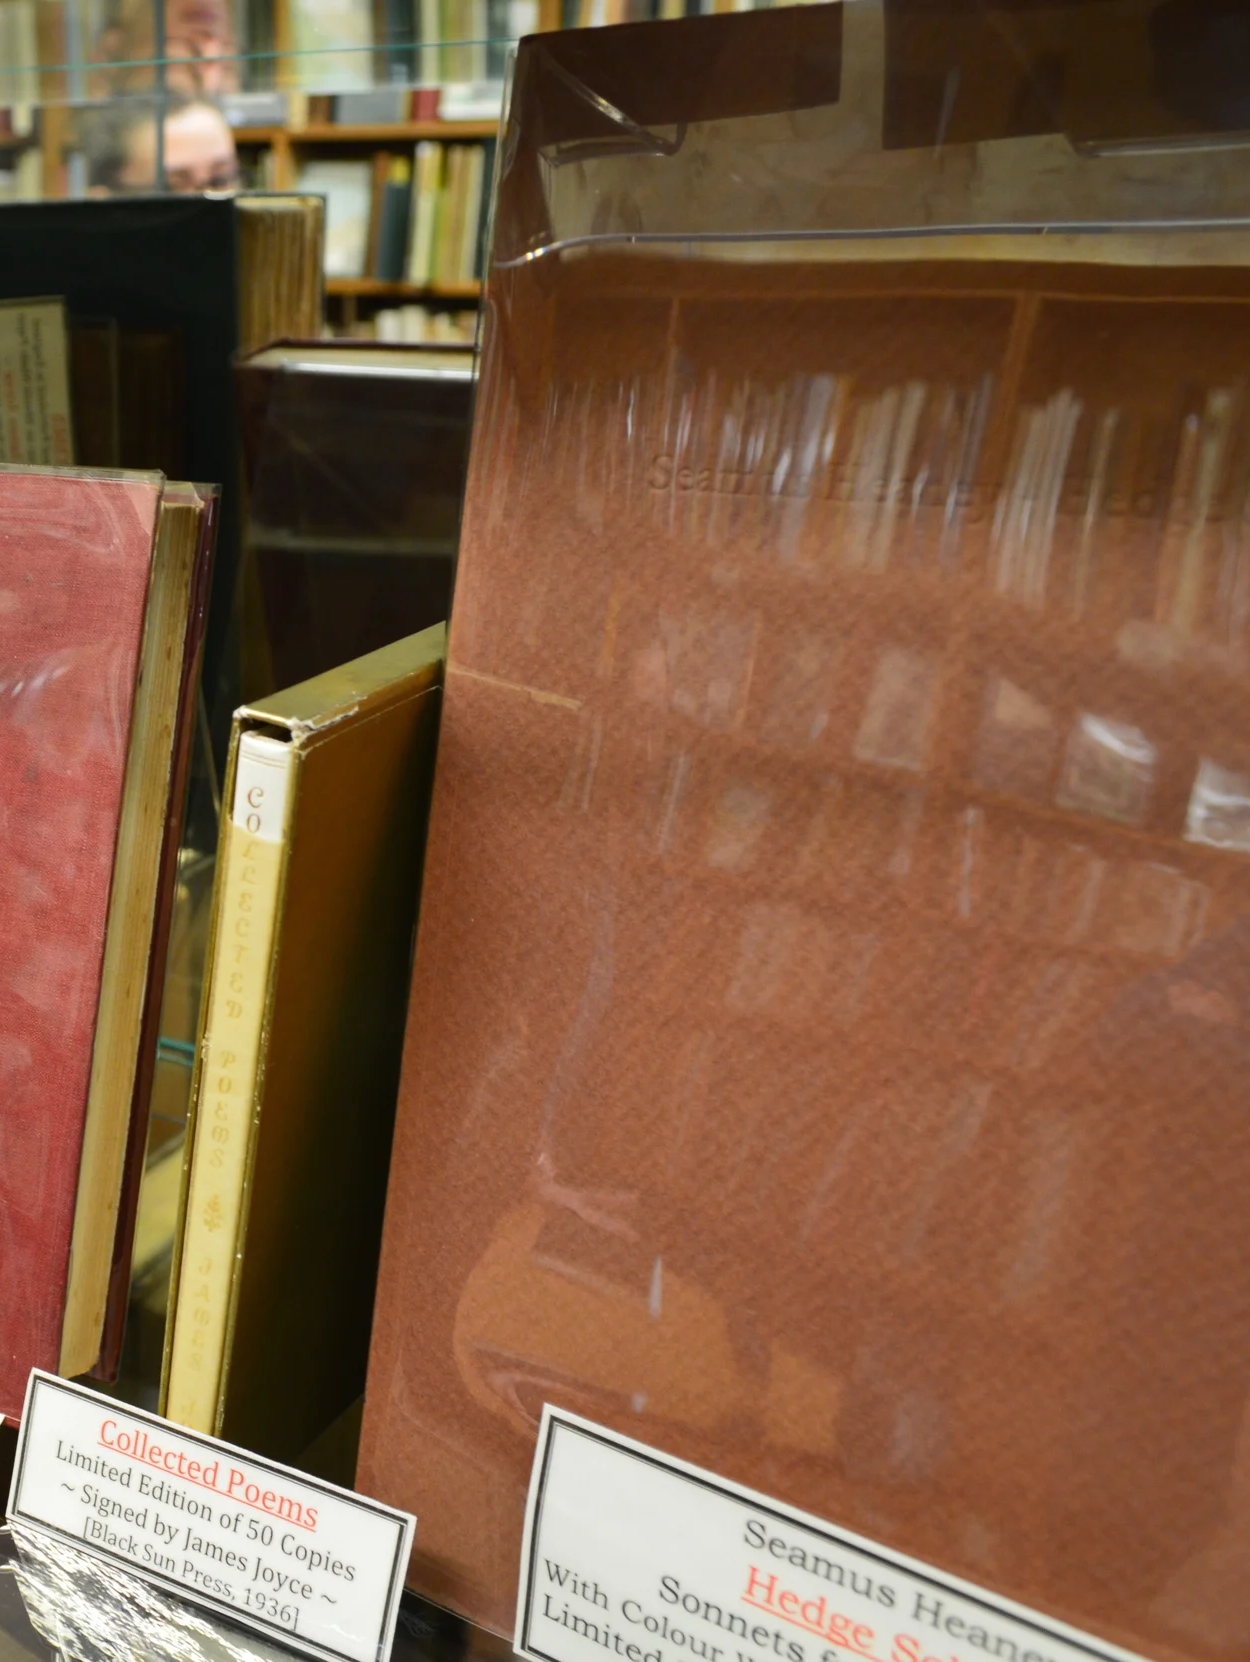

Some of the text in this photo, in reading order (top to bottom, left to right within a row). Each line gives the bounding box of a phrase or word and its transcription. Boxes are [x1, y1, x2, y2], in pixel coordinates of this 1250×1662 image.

[56, 1440, 356, 1582] Limited Edition of 50 Copies
[100, 1420, 319, 1528] Collected Poems
[80, 1484, 148, 1529] Signed
[154, 1513, 179, 1545] by
[183, 1527, 248, 1571] James
[252, 1557, 313, 1600] Joyce
[83, 1516, 299, 1631] [Black Sun Press, 1936]
[743, 1519, 1055, 1662] Seamus Heane
[544, 1558, 724, 1662] With Colour
[658, 1574, 804, 1662] Sonnets
[744, 1564, 875, 1649] Hedge
